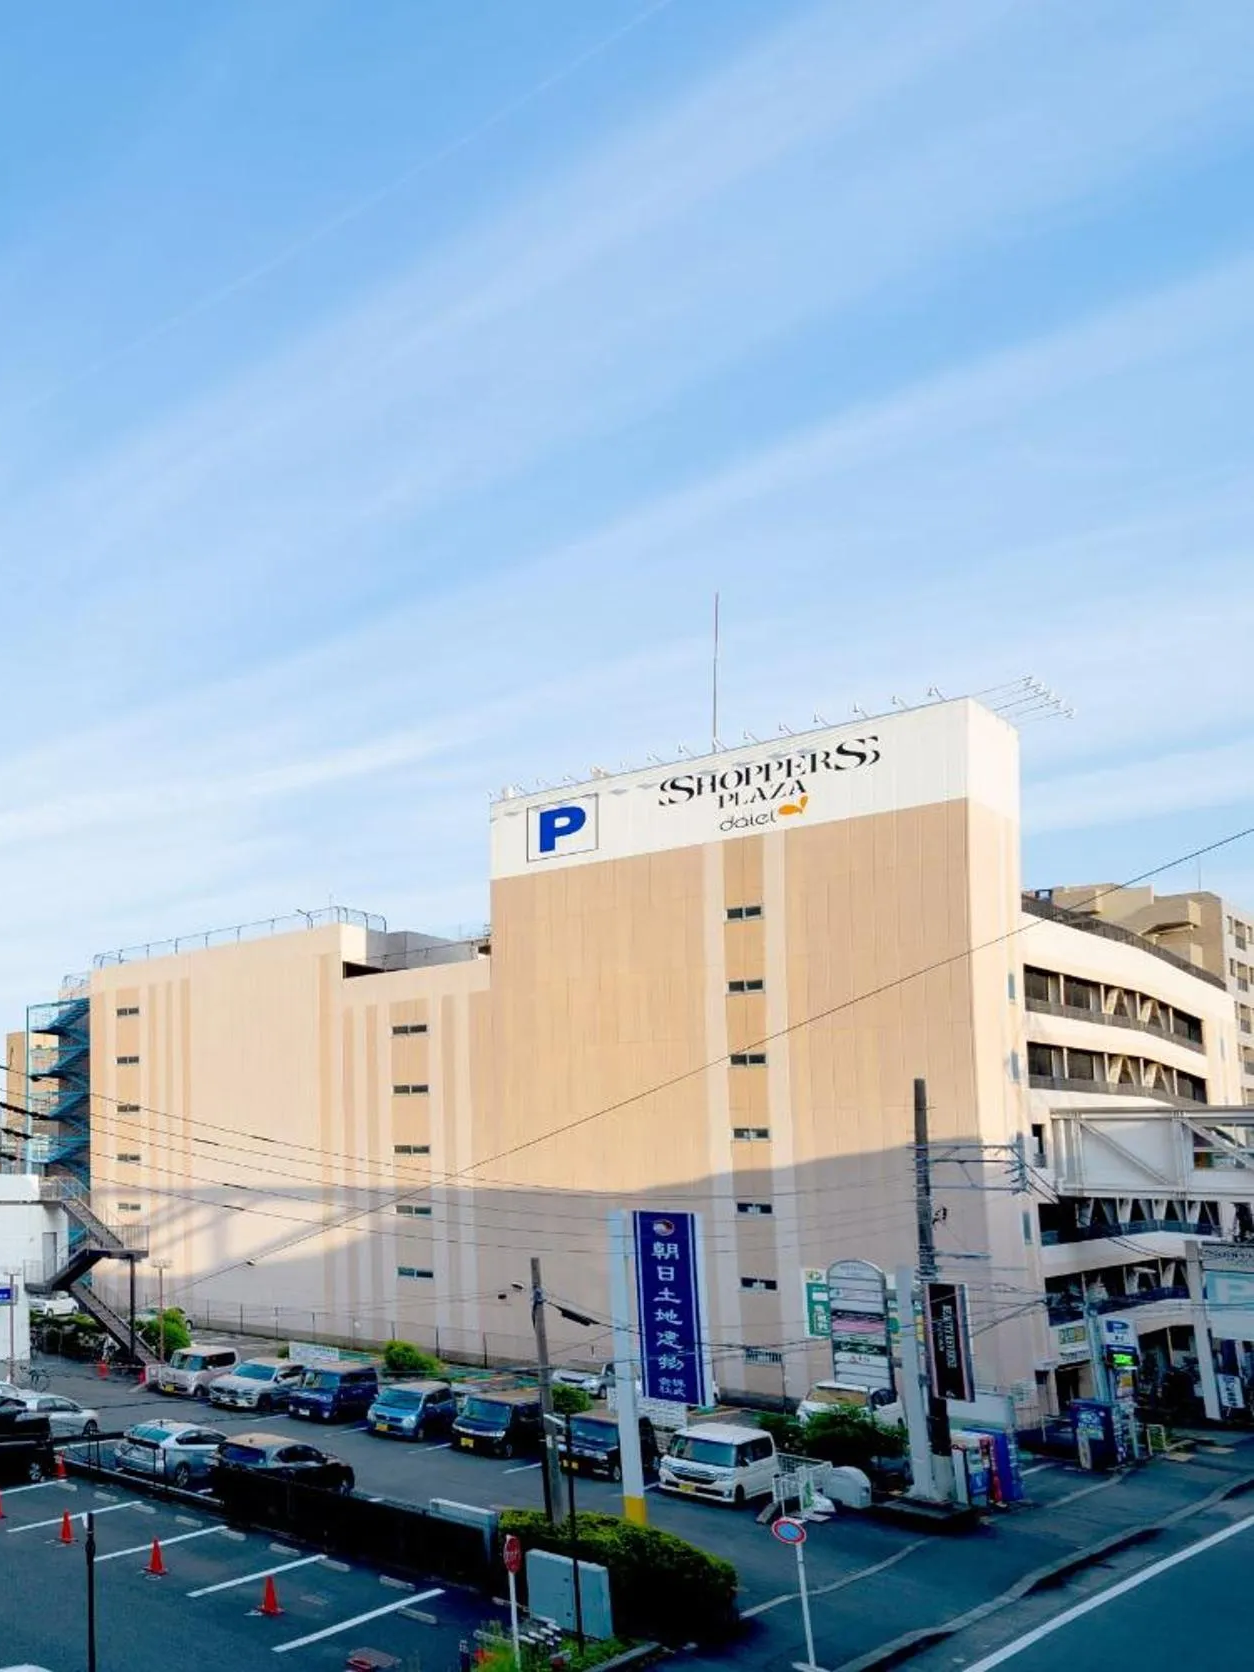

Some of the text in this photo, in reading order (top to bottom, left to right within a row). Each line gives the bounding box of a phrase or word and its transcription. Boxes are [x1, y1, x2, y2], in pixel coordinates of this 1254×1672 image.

[658, 735, 881, 806] SHOPPERS
[718, 779, 806, 809] PLAZA
[539, 806, 586, 853] P
